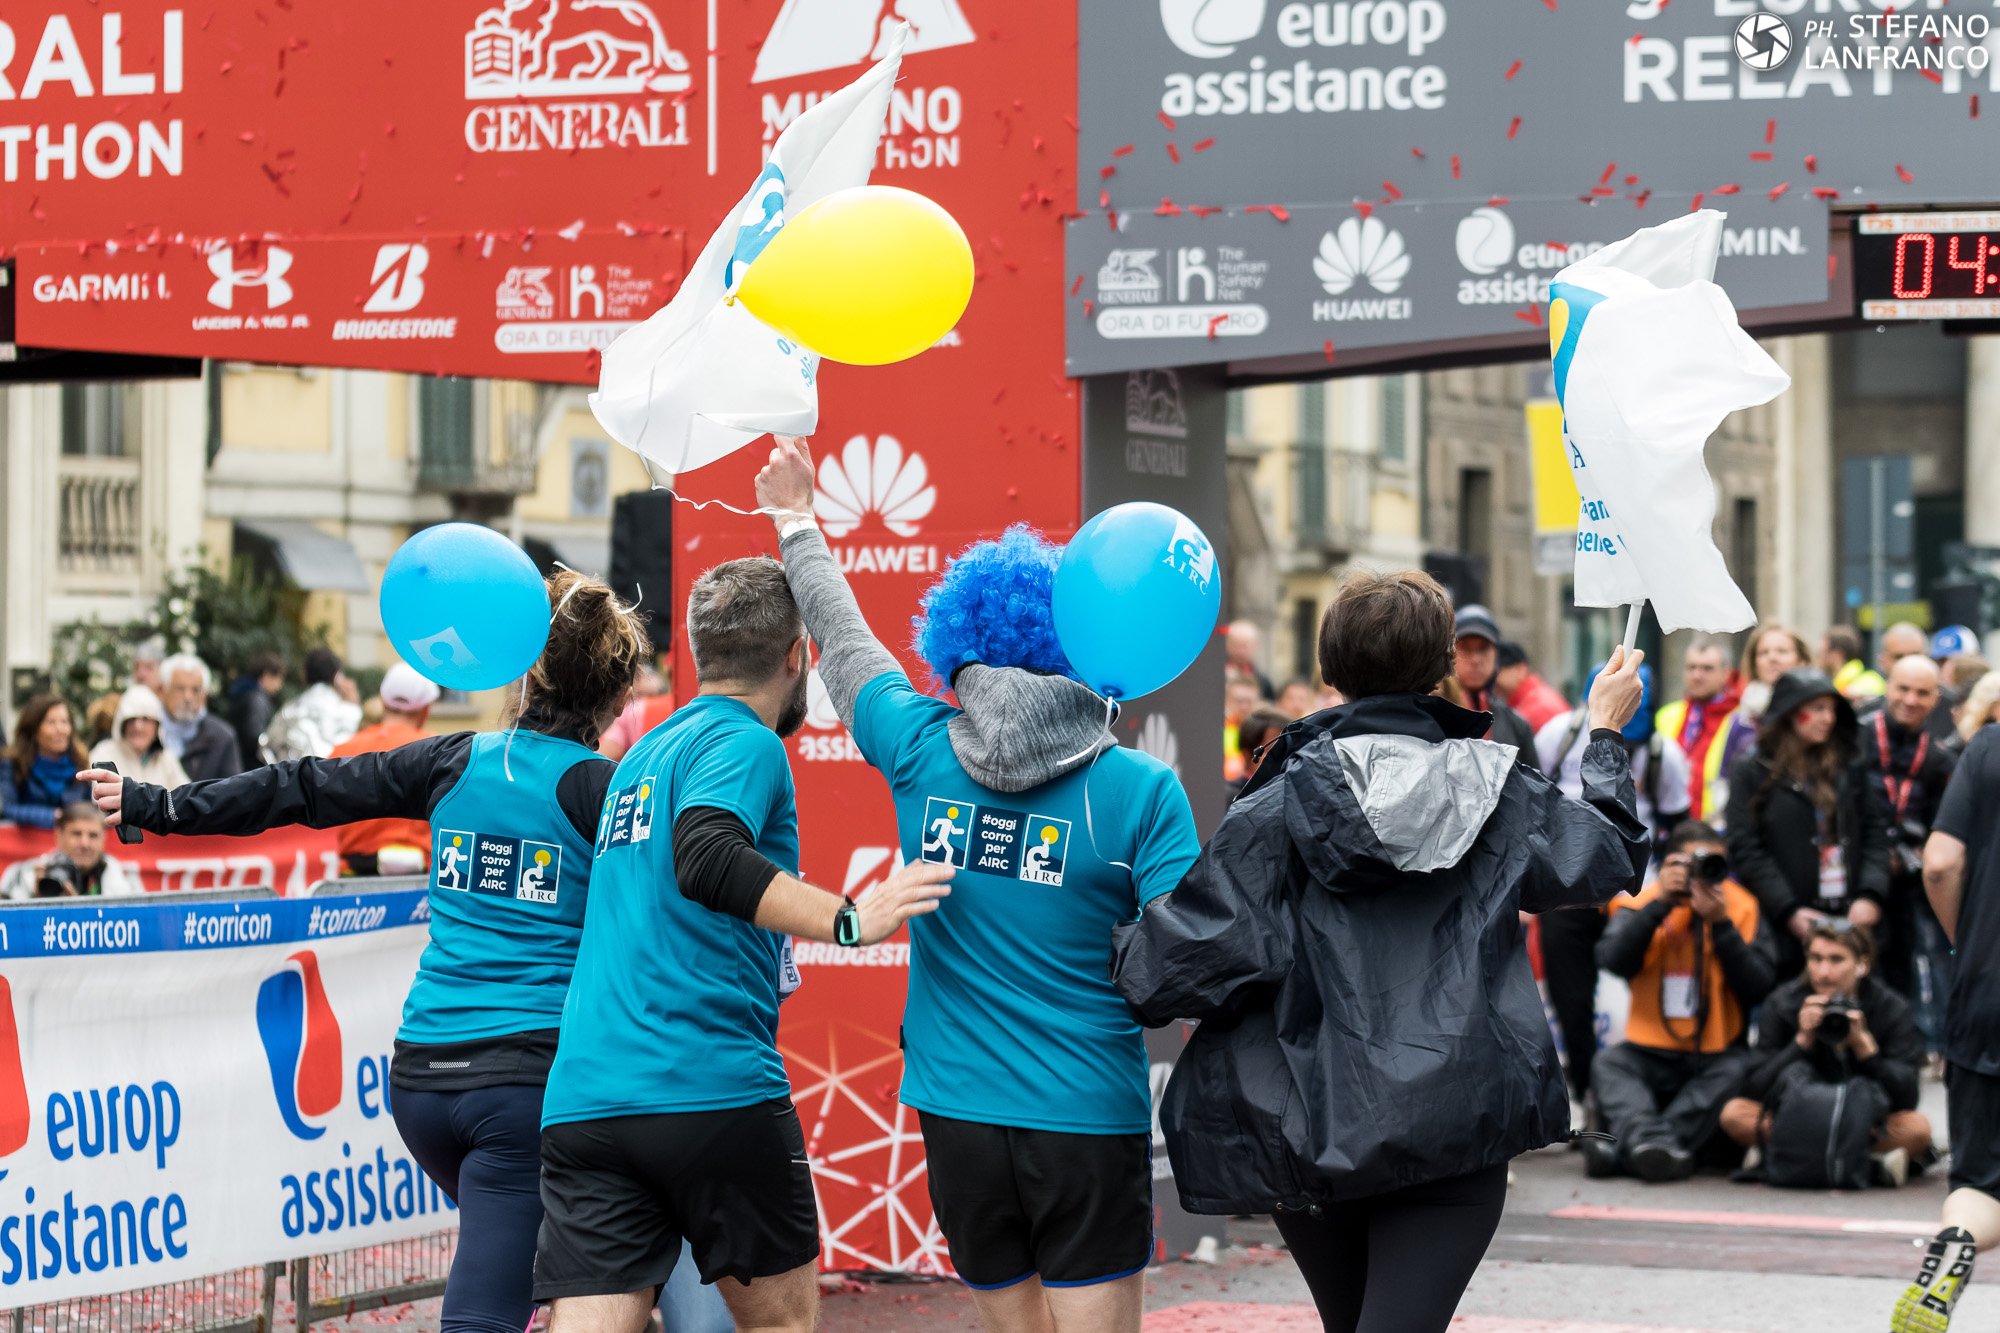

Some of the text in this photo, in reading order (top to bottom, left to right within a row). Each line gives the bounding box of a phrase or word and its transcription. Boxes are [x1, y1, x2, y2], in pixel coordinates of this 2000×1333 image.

[1277, 0, 1445, 55] europ
[1161, 55, 1447, 117] assistance
[464, 100, 690, 153] GENERALI
[1217, 248, 1245, 261] The
[607, 265, 631, 278] The
[1217, 261, 1268, 276] Human
[607, 280, 653, 292] Human
[1217, 275, 1263, 290] Safety
[607, 293, 648, 307] Safety
[1217, 289, 1242, 301] Net
[607, 306, 630, 318] Net
[1312, 299, 1411, 322] HUAWEI
[192, 316, 242, 331] UNDER
[332, 317, 456, 341] BRIDGESTONE
[1103, 315, 1145, 332] ORA
[1152, 314, 1170, 331] DI
[500, 331, 539, 347] ORA
[546, 330, 562, 346] DI
[1126, 439, 1187, 477] GENERALI
[832, 545, 936, 573] UAWEI
[1163, 554, 1209, 595] AIRC
[981, 814, 1017, 831] #oggi
[981, 831, 1014, 844] corro
[481, 841, 512, 855] #oggi
[985, 842, 1006, 855] per
[481, 854, 511, 867] corro
[978, 857, 1010, 870] AIRC
[485, 866, 504, 878] per
[1022, 869, 1062, 885] AIRC
[479, 877, 507, 891] AIRC
[518, 890, 556, 902] AIRC
[42, 908, 140, 951] #corricon
[184, 904, 272, 944] #corricon
[308, 897, 387, 936] #corricon
[794, 942, 911, 967] BRIDGEST
[46, 1080, 181, 1170] europ
